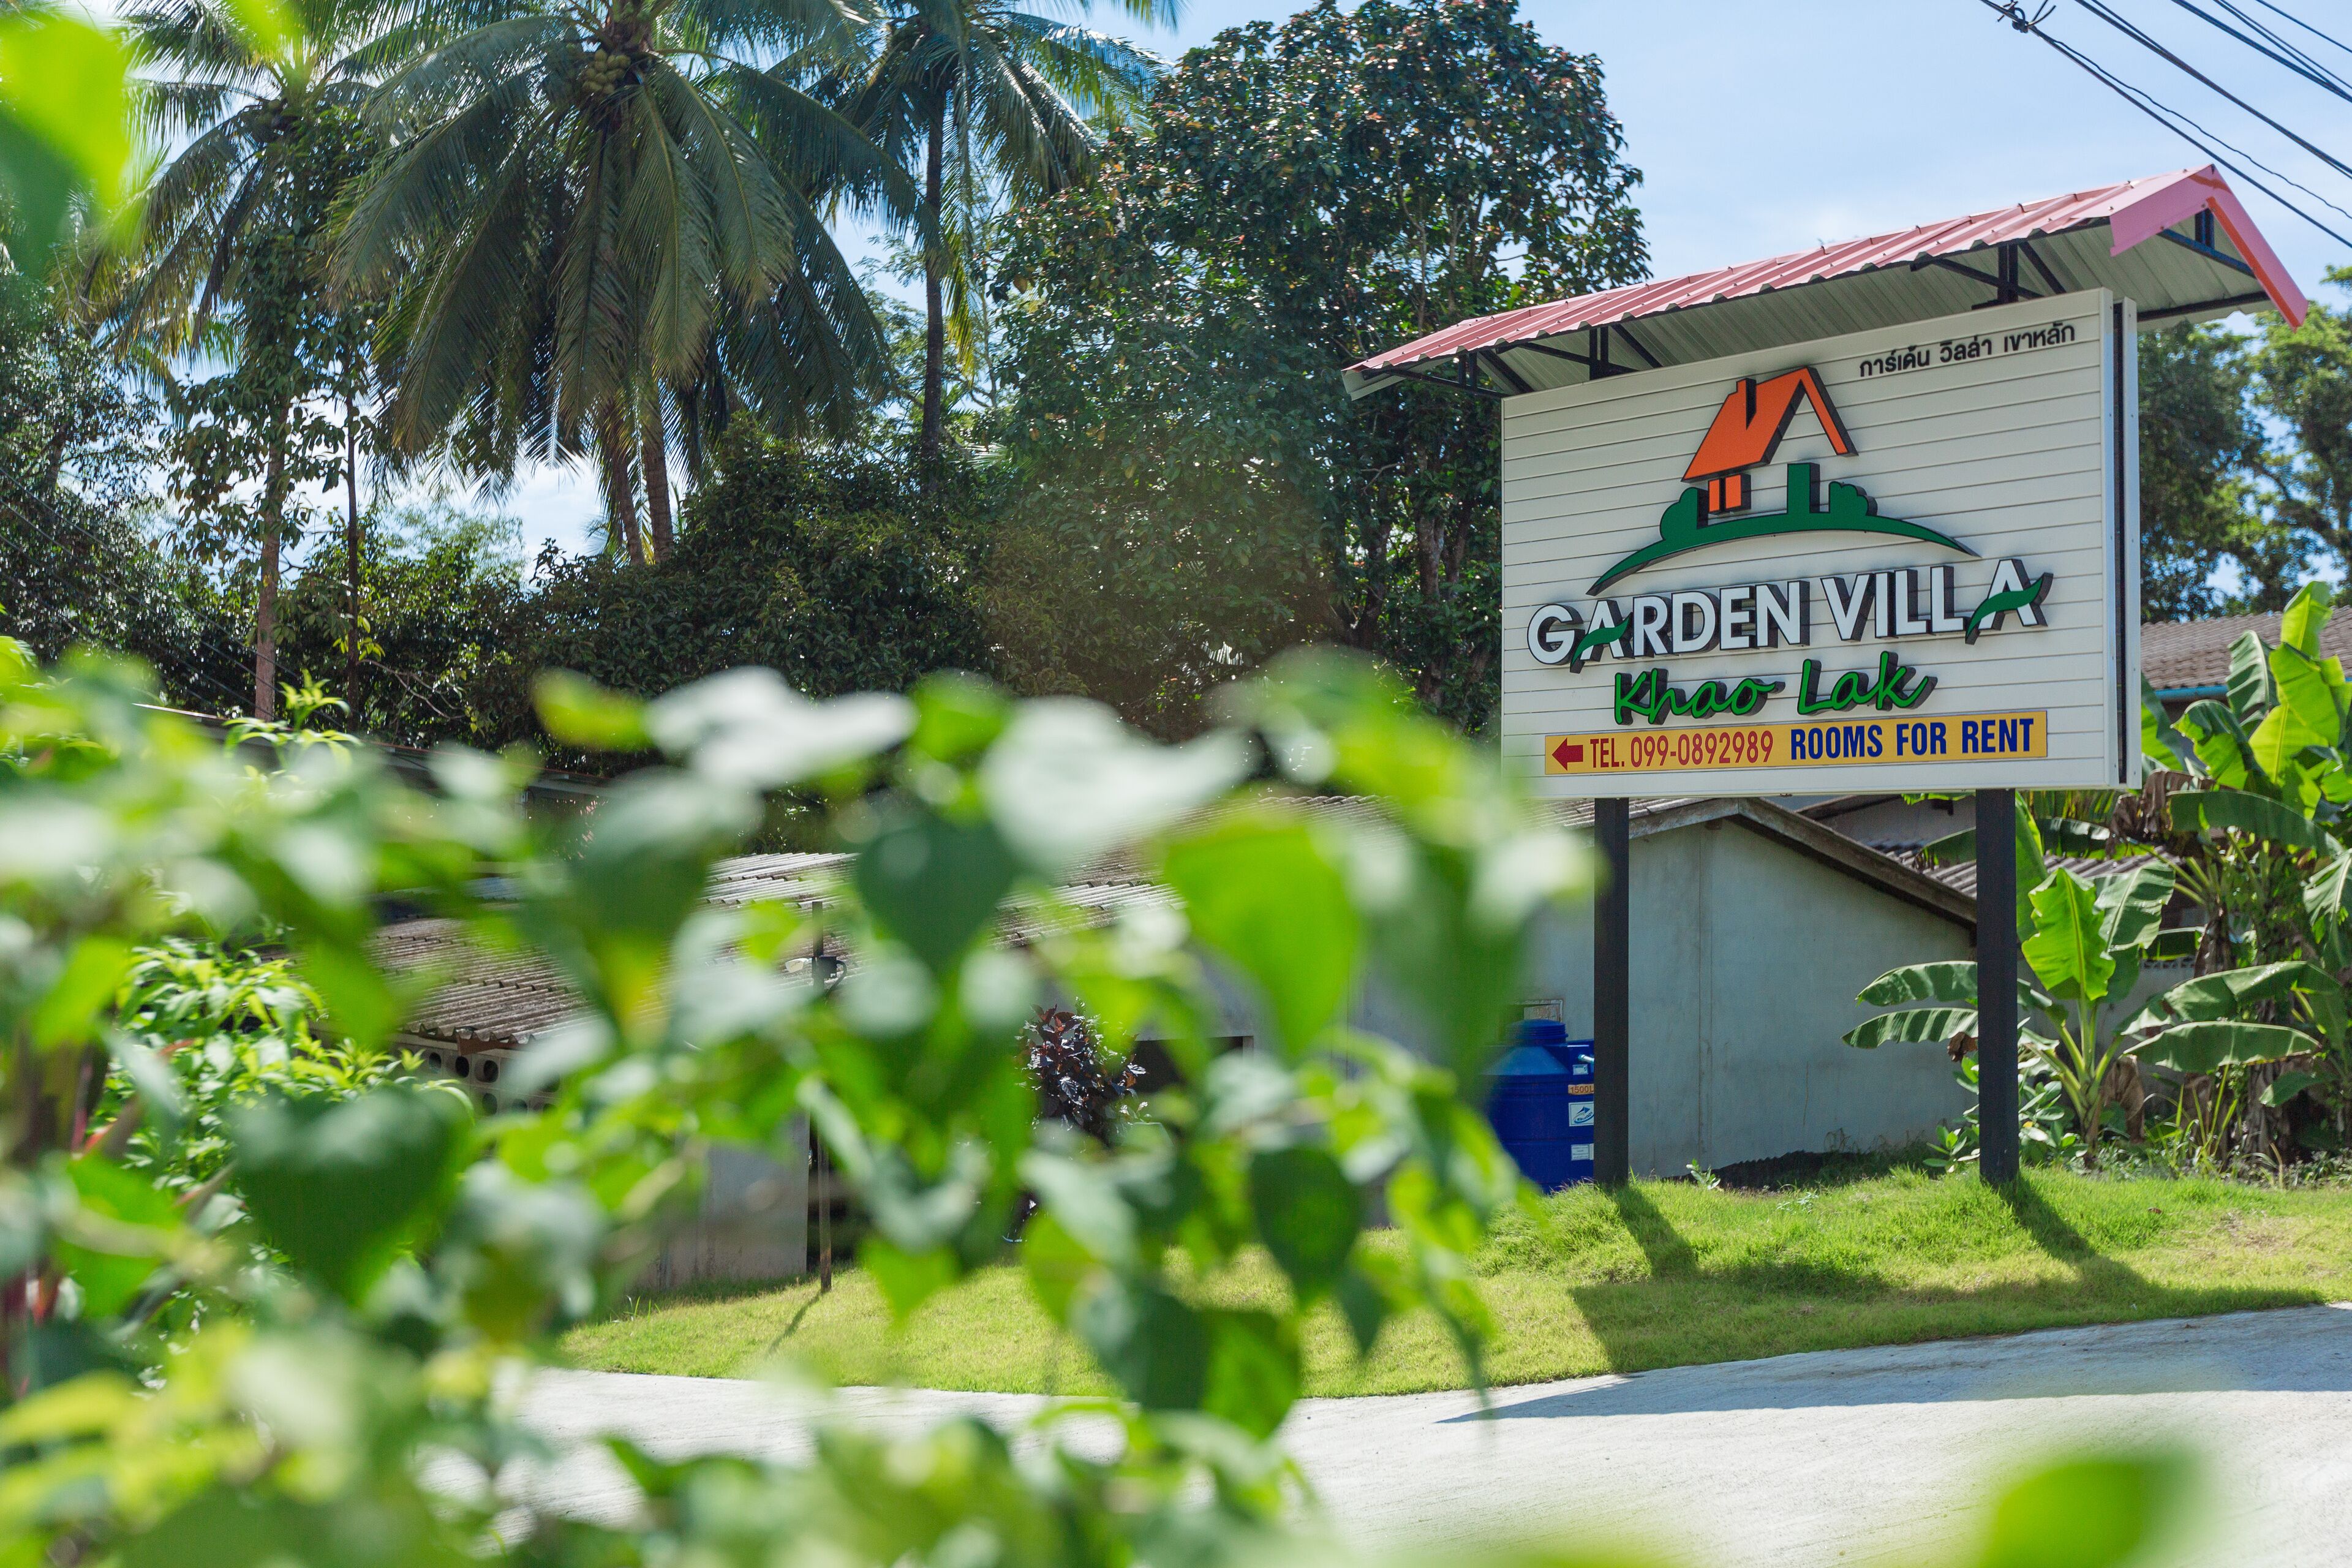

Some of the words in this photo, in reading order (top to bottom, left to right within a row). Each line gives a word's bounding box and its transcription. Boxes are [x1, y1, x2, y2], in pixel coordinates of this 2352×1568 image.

[1860, 345, 1930, 377] การ์เด้น
[1940, 335, 1992, 363] วิลล่า
[2004, 322, 2075, 352] เขาหลัก
[1527, 580, 1809, 673] GARDEN
[1820, 559, 2053, 644] VILLA
[1615, 668, 1784, 725] Khao
[1798, 651, 1937, 715] Lak
[1590, 737, 1624, 768] TEL.
[1630, 730, 1773, 767] 099-0892989
[1790, 724, 1883, 760] ROOMS
[1896, 722, 1947, 756] FOR
[1962, 718, 2034, 754] RENT
